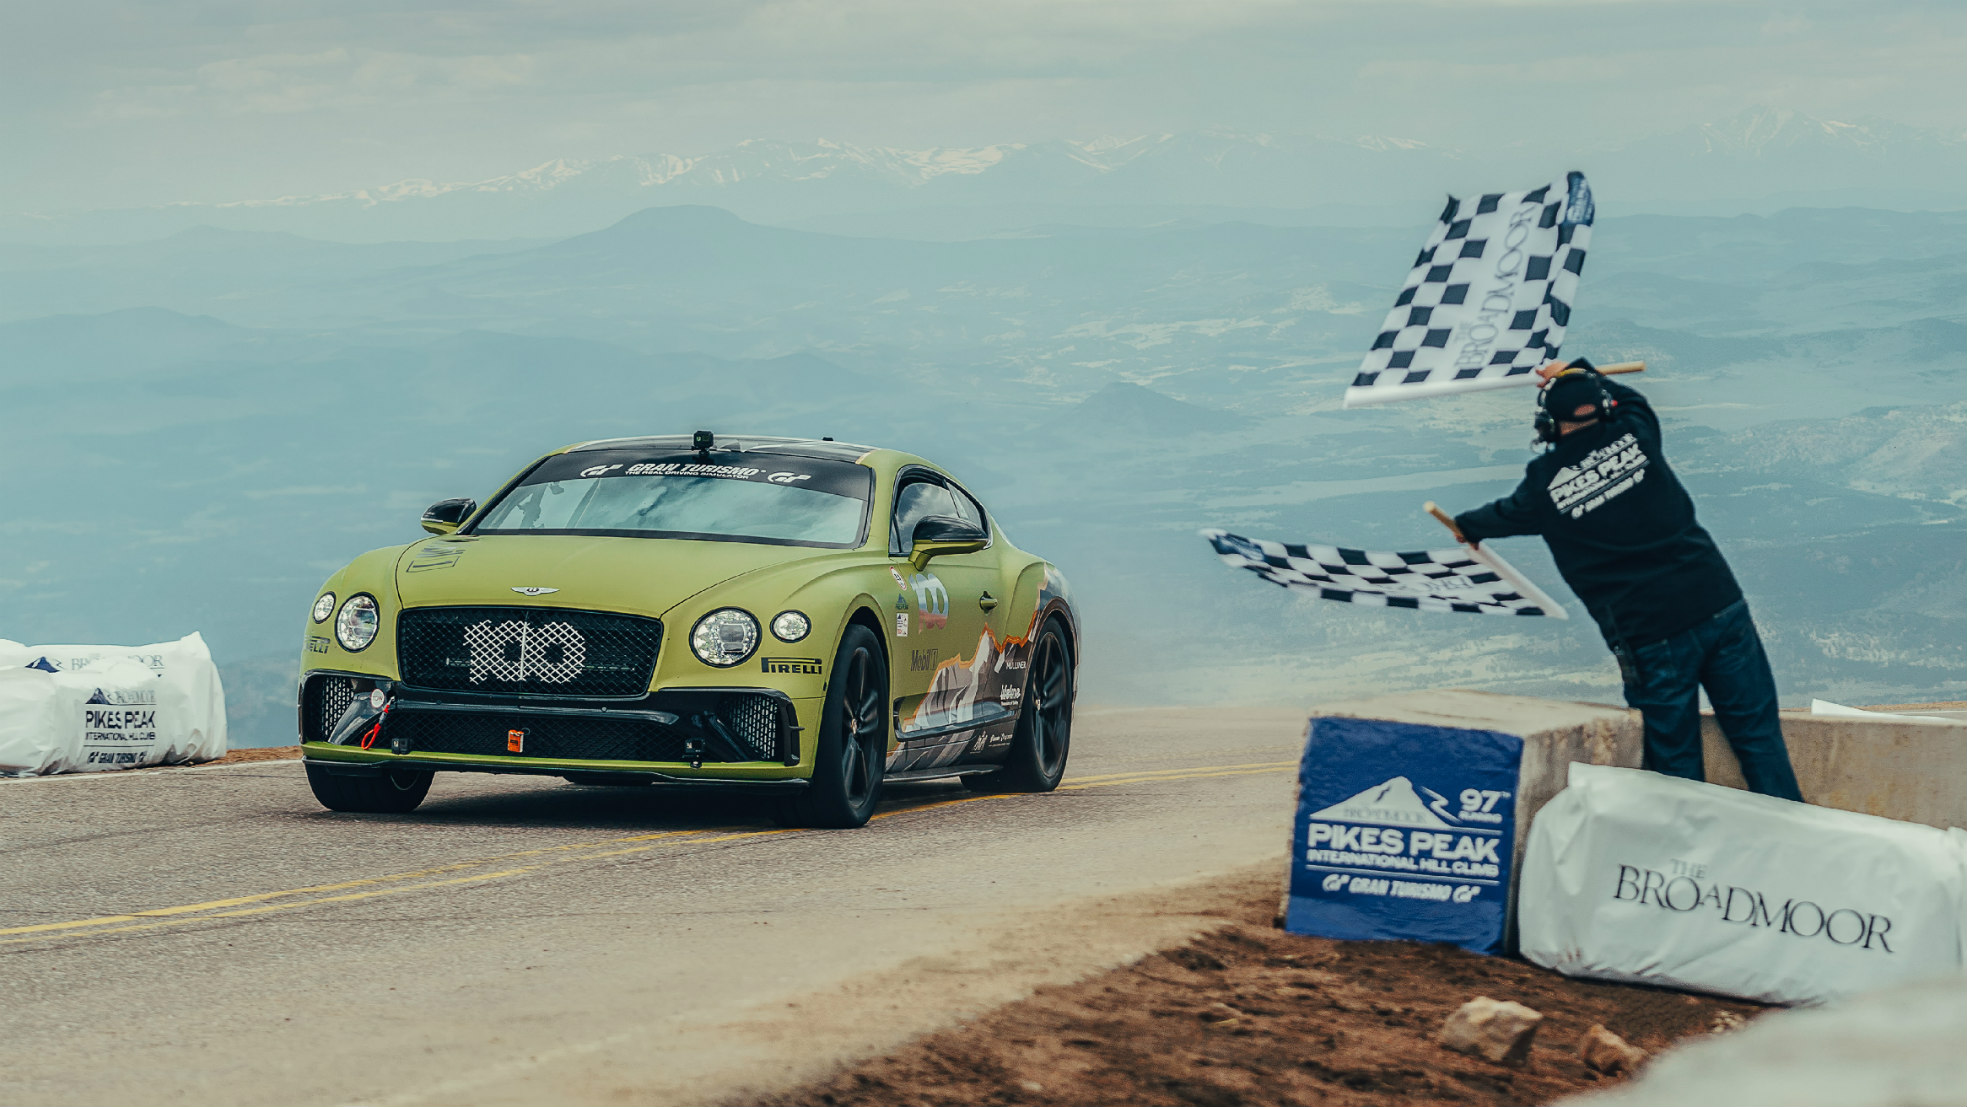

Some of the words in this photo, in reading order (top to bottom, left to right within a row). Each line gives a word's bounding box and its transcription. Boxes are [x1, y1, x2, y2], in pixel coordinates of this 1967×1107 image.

[1455, 205, 1536, 367] BROADMOOR
[628, 463, 679, 473] GRAN
[682, 463, 759, 476] TURISMO
[1550, 469, 1600, 503] PIKES
[1597, 443, 1642, 480] PEAK
[761, 657, 822, 674] PIRELLI
[85, 711, 122, 729] PIKES
[124, 711, 156, 729] PEAK
[1308, 822, 1405, 855] PIKES
[1409, 831, 1501, 863] PEAK
[1306, 849, 1418, 871] INTERNATIONAL
[1419, 857, 1451, 873] HILL
[1452, 861, 1500, 878] CLIMB
[1670, 859, 1708, 878] THE
[1349, 876, 1390, 896] GRAN
[1390, 880, 1453, 902] TURISMO
[1613, 863, 1894, 953] BROADMOOR
